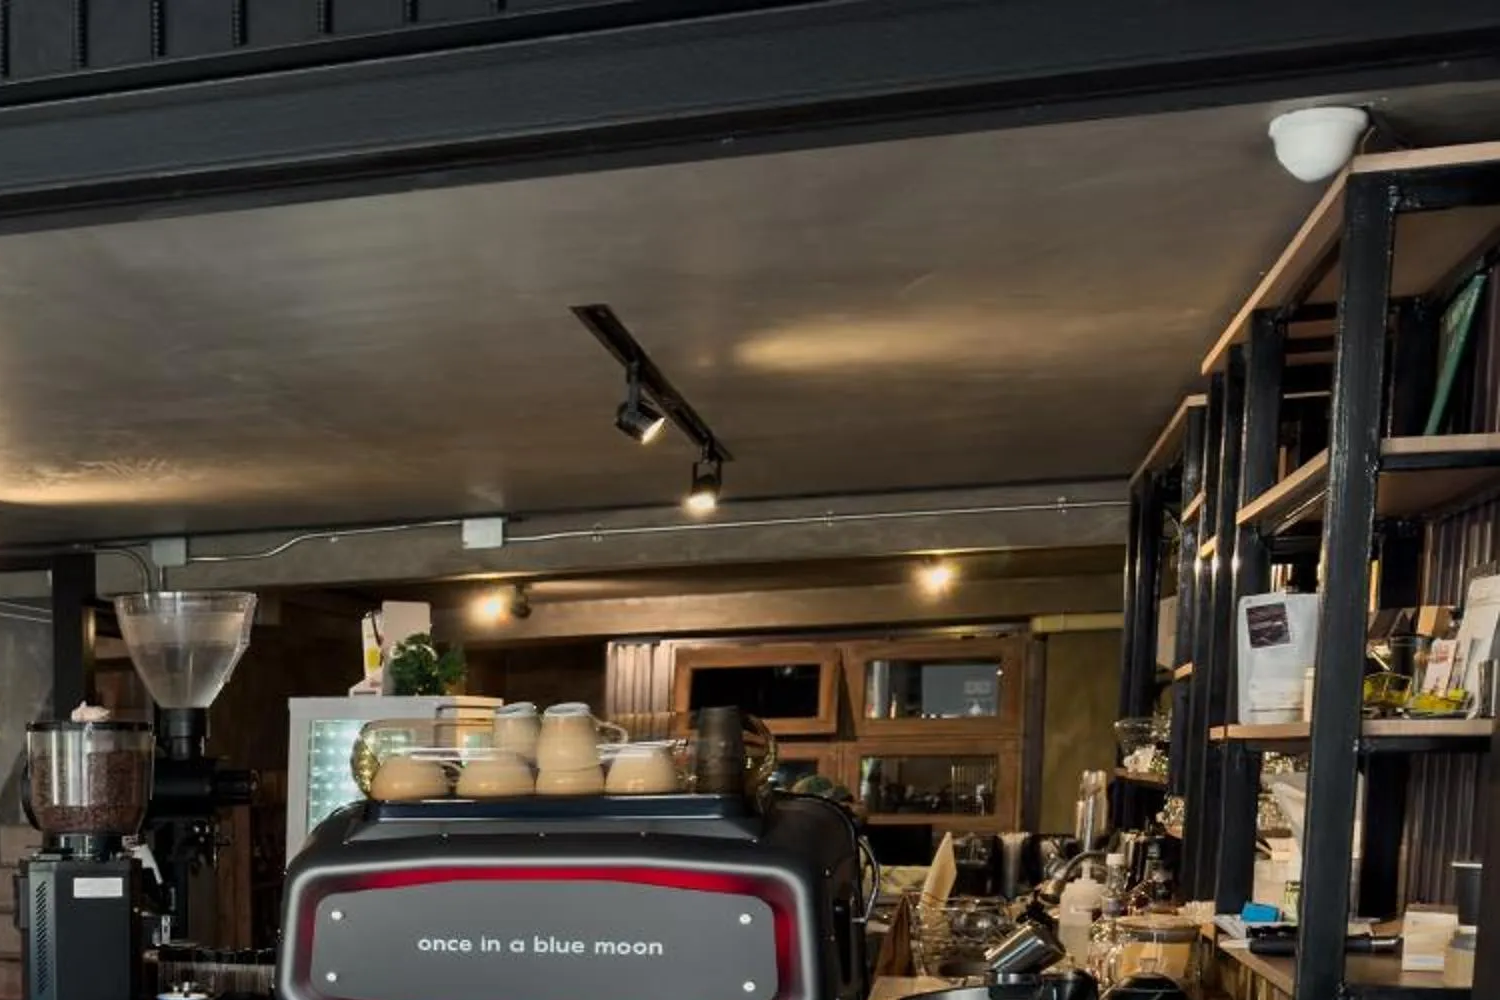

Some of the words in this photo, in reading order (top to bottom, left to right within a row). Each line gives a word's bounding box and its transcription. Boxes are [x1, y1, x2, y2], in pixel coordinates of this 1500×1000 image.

[417, 936, 473, 952] once
[481, 935, 501, 953] in
[509, 938, 525, 953] a
[533, 935, 585, 954] blue
[594, 939, 664, 956] moon
